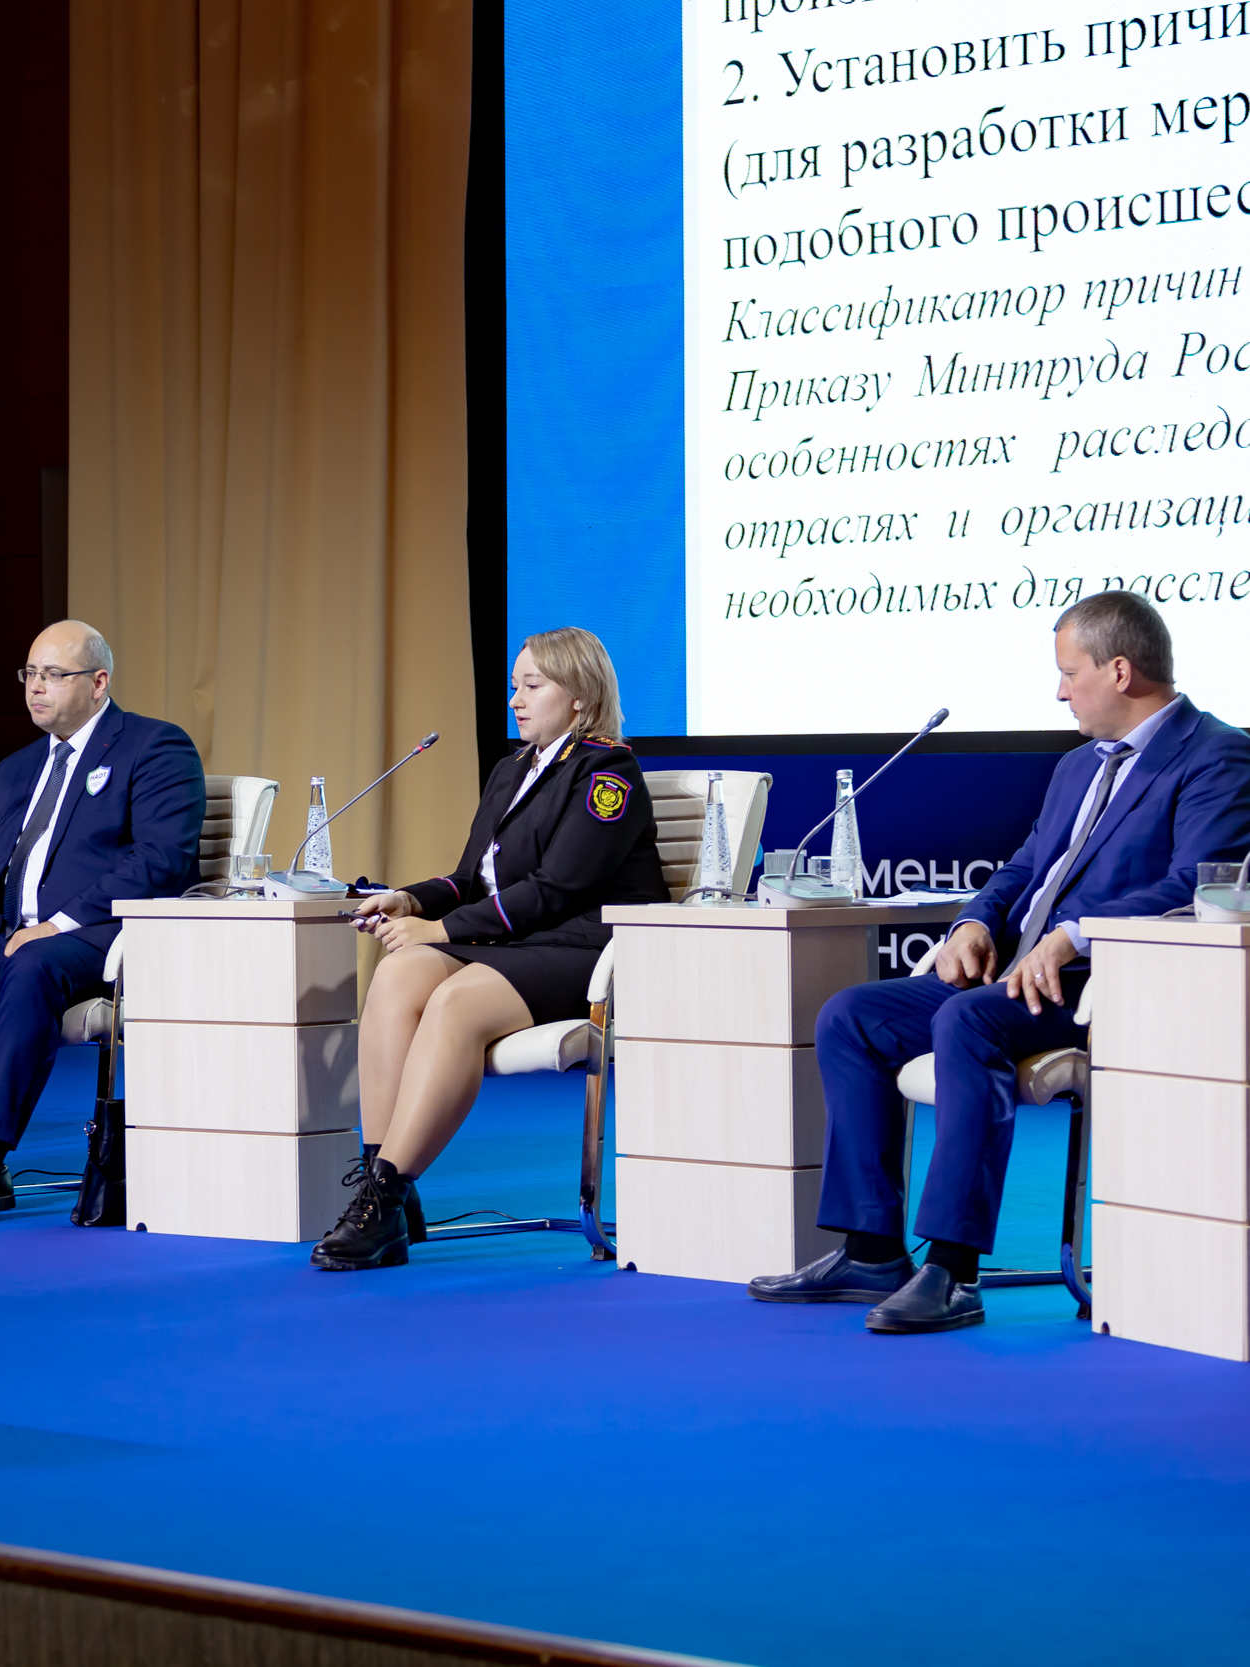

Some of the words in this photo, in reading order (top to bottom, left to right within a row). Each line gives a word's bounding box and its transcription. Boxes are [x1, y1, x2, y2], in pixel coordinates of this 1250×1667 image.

[723, 60, 759, 106] 2.
[778, 30, 1066, 98] Установить
[1084, 1, 1250, 69] причи
[724, 140, 822, 200] (для
[842, 105, 1129, 189] разработки
[1151, 91, 1250, 144] мер
[724, 208, 978, 270] подобного
[723, 284, 1066, 343] Классификатор
[1083, 266, 1242, 321] причин
[723, 370, 892, 422] Приказу
[914, 339, 1149, 400] Минтруда
[725, 436, 1016, 481] особенностях
[725, 511, 918, 559] отраслях
[948, 508, 970, 538] и
[725, 572, 998, 620] необходимых
[1012, 565, 1085, 609] для
